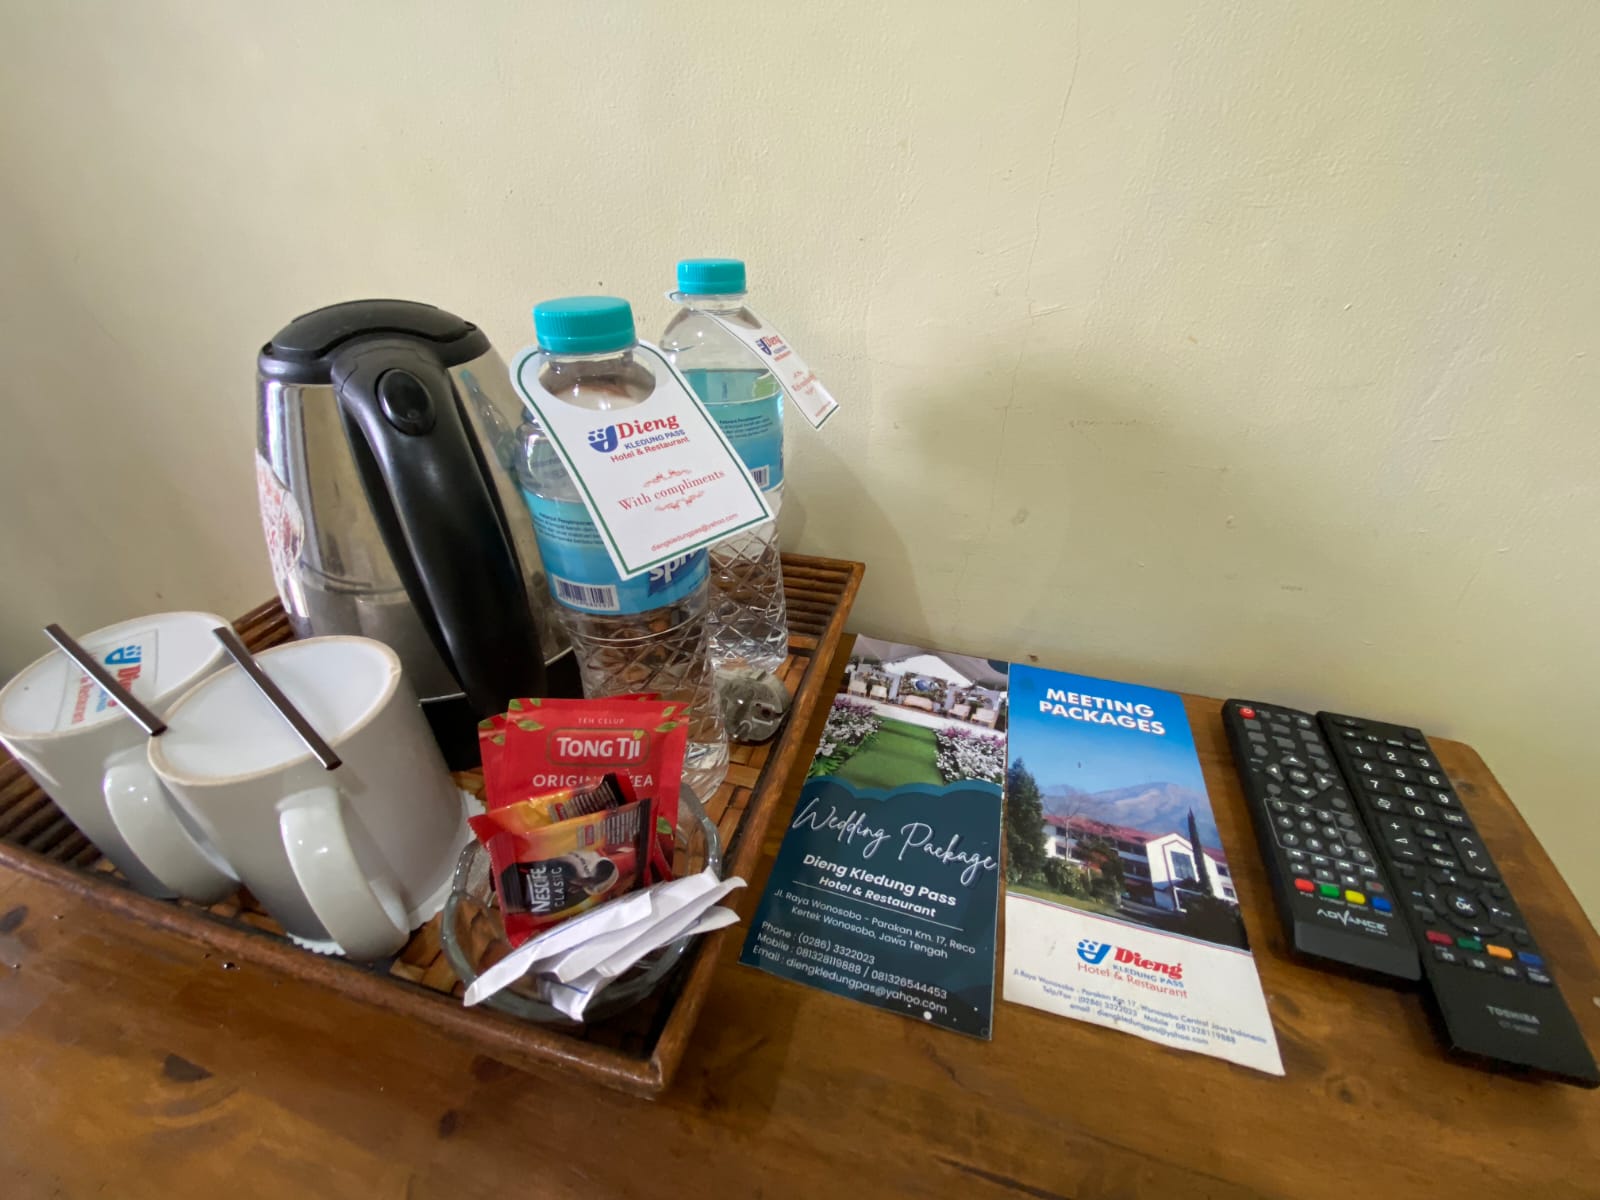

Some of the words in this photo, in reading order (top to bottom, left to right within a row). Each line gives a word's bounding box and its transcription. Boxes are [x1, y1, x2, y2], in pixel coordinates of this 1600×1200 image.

[616, 415, 680, 439] Dieng
[624, 434, 664, 450] KLEDUNG
[665, 429, 686, 440] PASS
[610, 450, 634, 463] Hotel
[644, 436, 690, 454] Restaurant
[618, 492, 652, 511] With
[654, 470, 725, 500] compliments
[1040, 700, 1166, 735] PACKAGES
[1046, 688, 1154, 718] MEETING
[556, 737, 614, 758] TONG
[1386, 752, 1397, 760] 2
[1419, 758, 1430, 767] 3
[532, 774, 604, 787] ORIGI
[1364, 763, 1372, 771] 4
[1396, 768, 1406, 778] 5
[1428, 776, 1439, 784] 6
[1370, 780, 1378, 788] 7
[1404, 786, 1415, 796] 8
[1438, 794, 1448, 804] 9
[1414, 806, 1424, 816] 0
[792, 798, 892, 859] Wedding
[898, 822, 998, 886] Package
[803, 854, 848, 878] Dieng
[850, 867, 916, 896] Kledung
[918, 886, 957, 906] Pass
[819, 876, 852, 892] Hotel
[852, 886, 862, 896] &
[865, 890, 936, 917] Restaurant
[786, 891, 809, 906] Raya
[812, 899, 862, 920] Wonosobo
[872, 916, 912, 936] Parakan
[914, 930, 932, 942] Km.
[950, 939, 976, 954] Reco
[792, 906, 821, 921] Kertek
[823, 915, 876, 940] Wonosobo,
[879, 932, 906, 947] Jawa
[909, 940, 948, 959] Tengah
[752, 944, 780, 961] Email
[757, 932, 790, 951] Mobile
[796, 946, 862, 974] 081328119888
[762, 920, 792, 938] Phone
[798, 932, 832, 952] (0286)
[833, 944, 876, 965] 3322023
[1112, 964, 1158, 982] KLEDUNG
[1160, 977, 1184, 989] PASS
[1114, 946, 1182, 980] Dieng
[1078, 962, 1110, 977] Hotel
[1114, 972, 1124, 982] &
[1127, 974, 1188, 998] Restaurant
